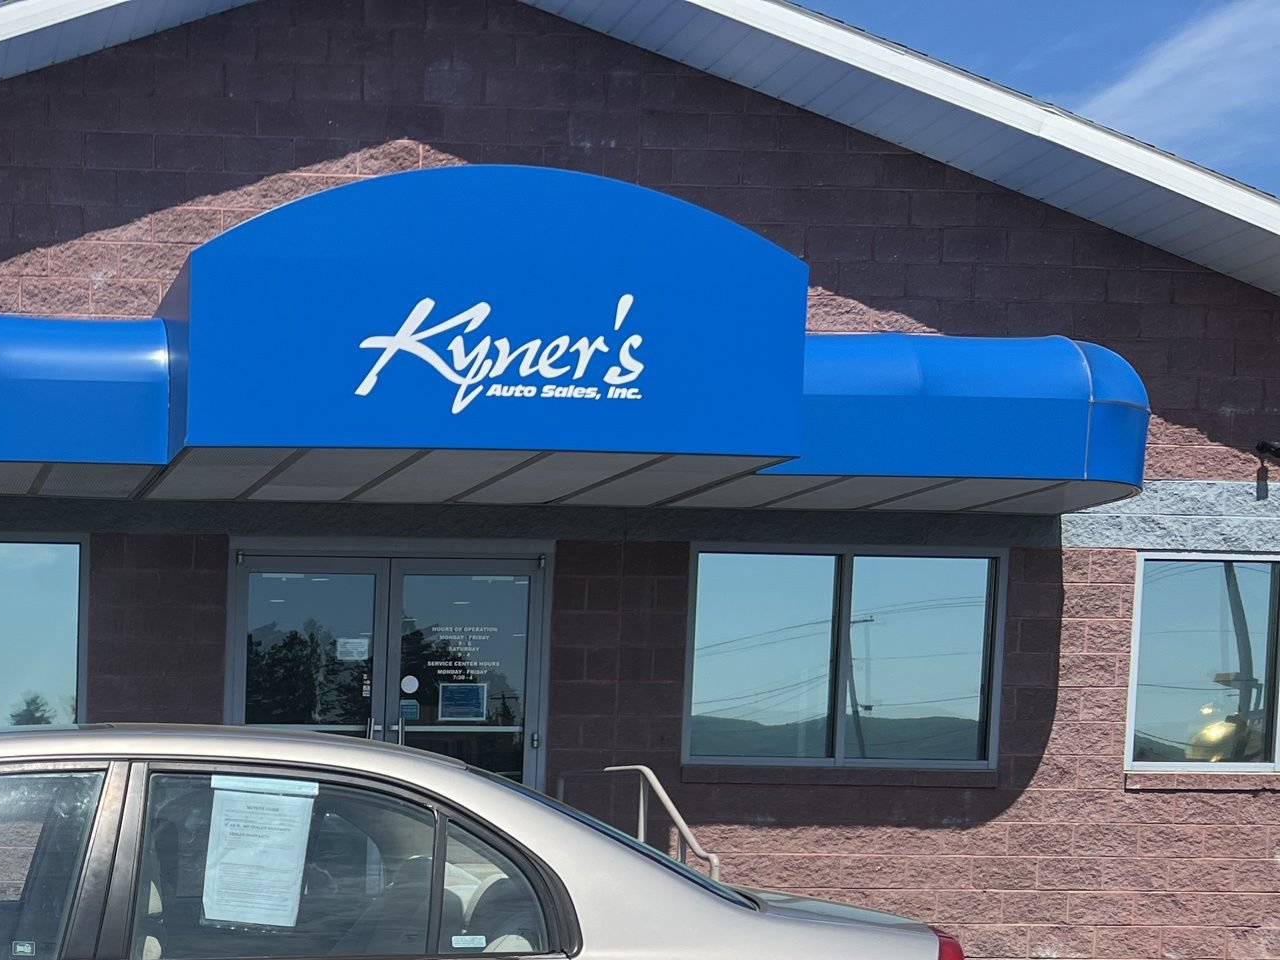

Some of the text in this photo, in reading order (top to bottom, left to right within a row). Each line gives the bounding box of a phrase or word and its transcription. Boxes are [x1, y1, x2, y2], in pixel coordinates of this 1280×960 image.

[355, 294, 644, 414] Kyner's
[486, 384, 642, 399] Auto Sales, Inc.
